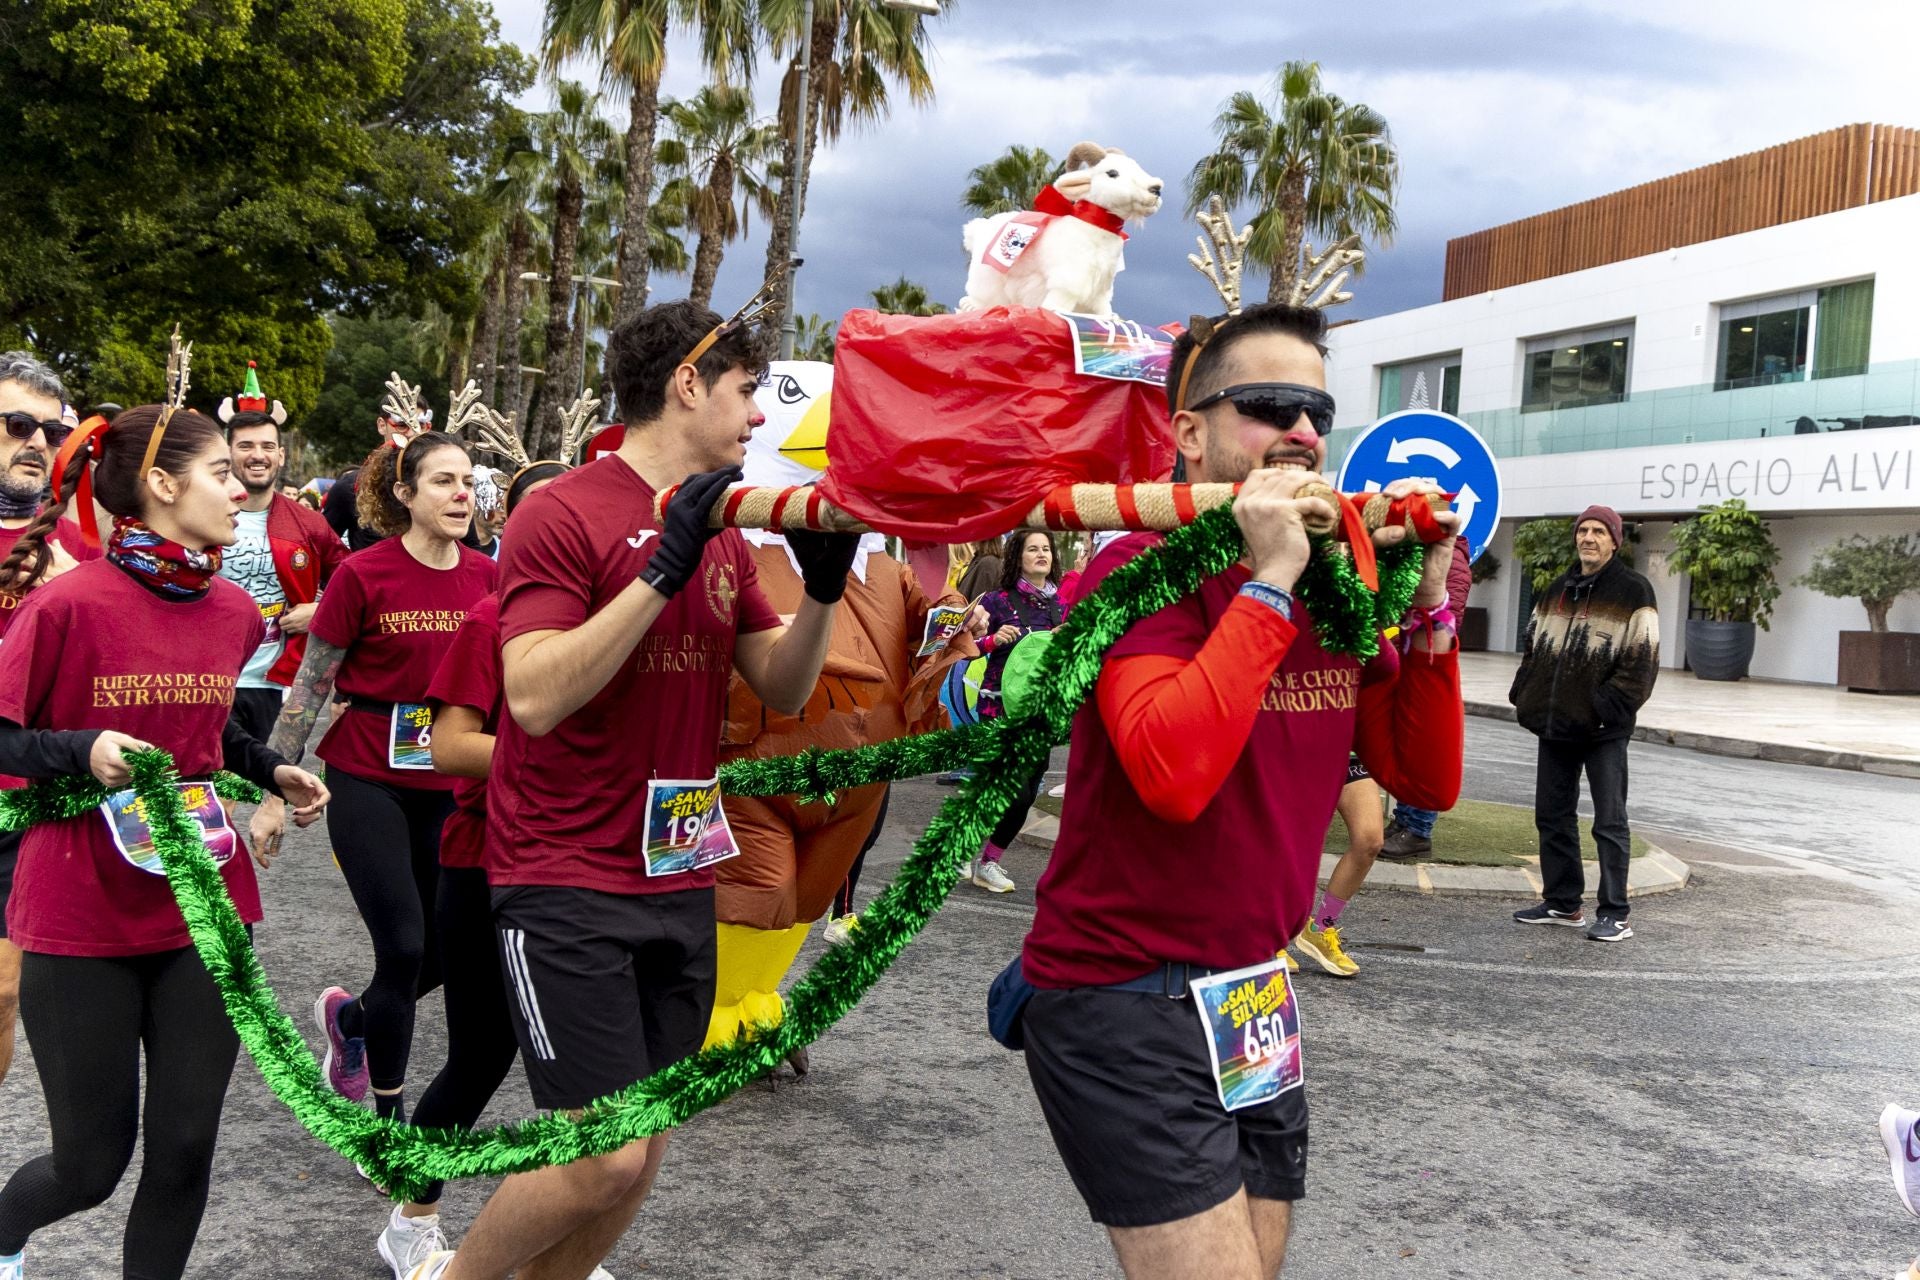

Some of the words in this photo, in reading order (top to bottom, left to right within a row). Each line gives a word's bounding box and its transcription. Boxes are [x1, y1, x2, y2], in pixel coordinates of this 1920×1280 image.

[1640, 458, 1792, 500] ESPACIO
[379, 610, 434, 624] FUERZAS
[435, 610, 452, 621] DE
[380, 620, 463, 634] EXTRAORD
[93, 673, 173, 690] FUERZAS
[176, 673, 197, 687] DE
[417, 725, 431, 747] 6
[675, 789, 707, 806] SAN
[1228, 979, 1256, 1010] SAN
[1231, 971, 1286, 1029] SILVESTRE
[1243, 1012, 1287, 1063] 650
